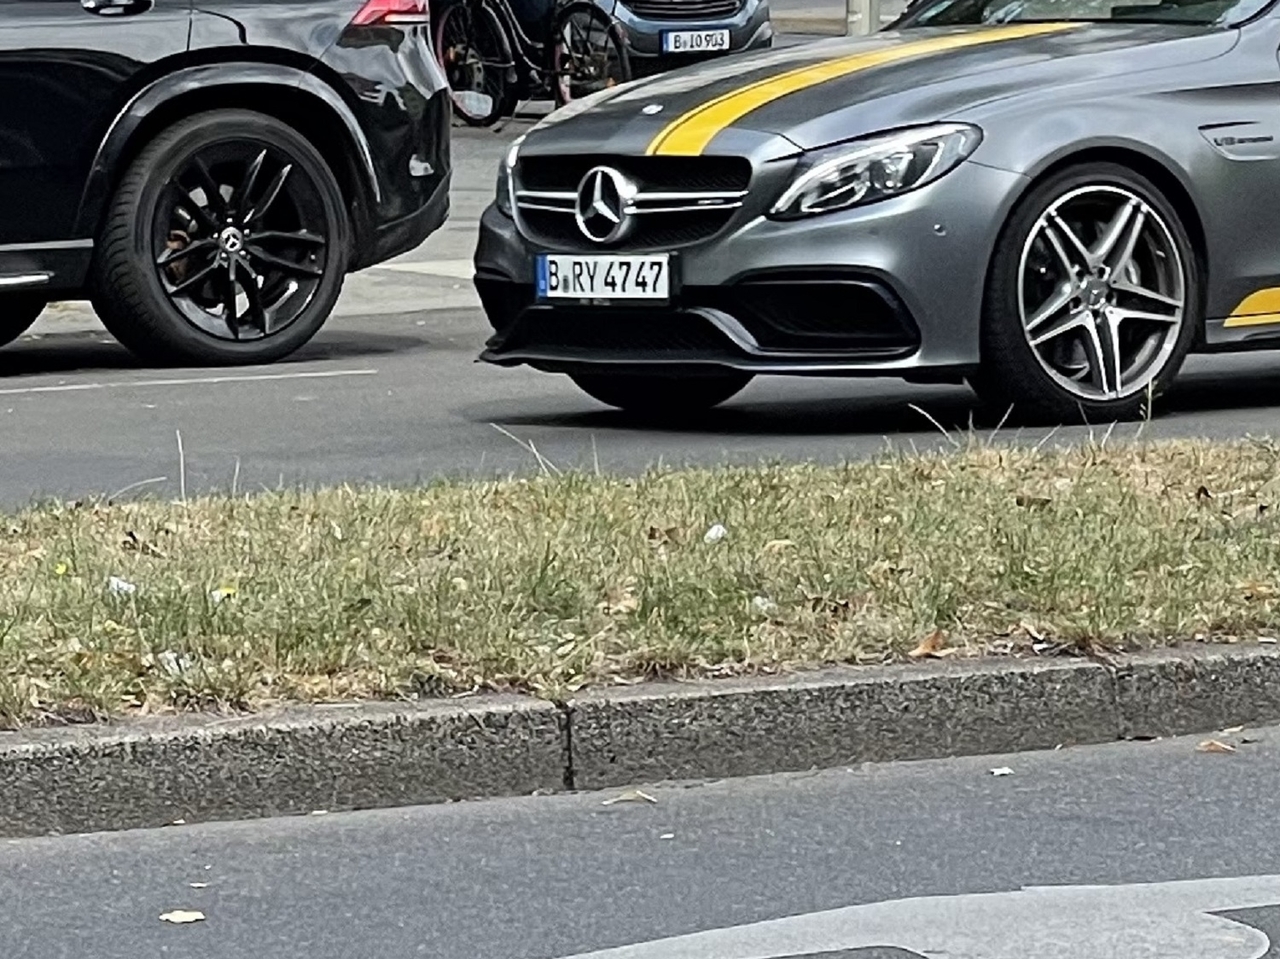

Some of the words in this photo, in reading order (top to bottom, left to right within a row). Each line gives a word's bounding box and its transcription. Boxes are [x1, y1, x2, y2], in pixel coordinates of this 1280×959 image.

[549, 260, 560, 291] B
[572, 261, 598, 292] RY
[604, 261, 663, 293] 4747
